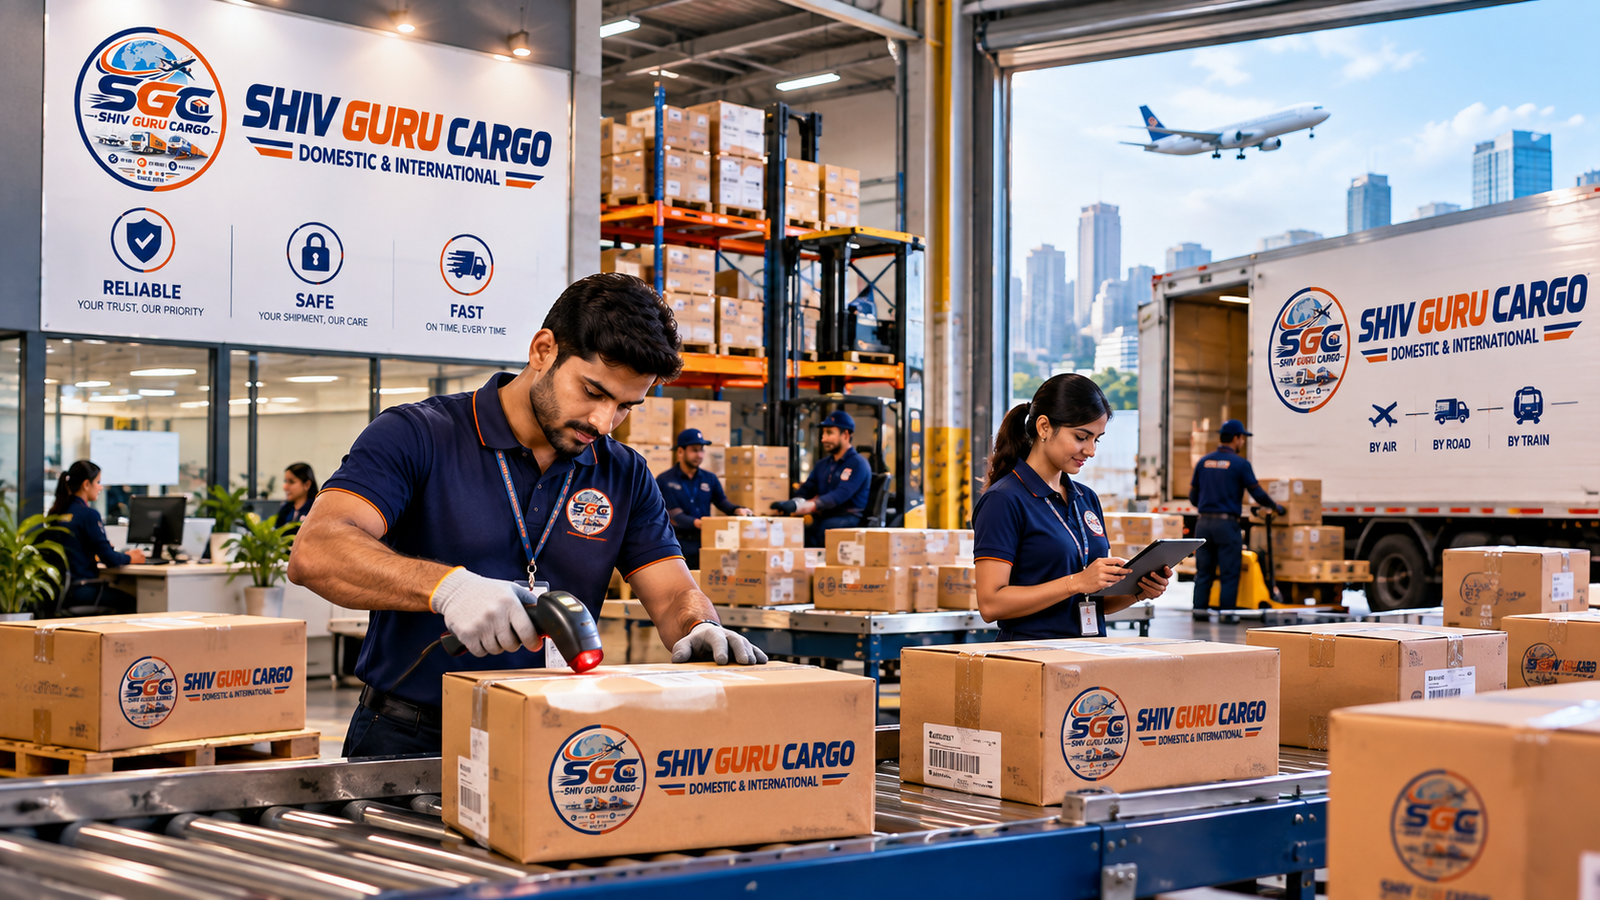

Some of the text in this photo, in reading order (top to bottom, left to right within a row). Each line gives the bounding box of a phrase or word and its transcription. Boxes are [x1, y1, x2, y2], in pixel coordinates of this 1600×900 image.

[91, 75, 215, 123] SGC
[98, 112, 211, 136] SHIV GURU CARGO
[242, 83, 552, 167] SHIV GURU CARGO
[299, 143, 500, 186] DOMESTIC & INTERNATIONAL
[103, 280, 181, 300] RELIABLE
[77, 300, 204, 316] YOUR TRUST, OUR PRIORITY
[295, 292, 334, 310] SAFE
[1358, 273, 1588, 343] SHIV GURU CARGO
[259, 311, 368, 327] YOUR SHIPMENT, OUR CARE
[450, 303, 484, 320] FAST
[425, 322, 507, 335] ON TIME, EVERY TIME
[1276, 324, 1343, 358] SGC
[1391, 328, 1539, 361] DOMESTIC & INTERNATIONAL
[1317, 352, 1340, 364] CARGO
[1369, 441, 1397, 453] BY AIR
[1433, 438, 1471, 450] BY ROAD
[1508, 434, 1550, 447] BY TRAIN
[572, 502, 609, 515] SGC
[125, 678, 174, 697] SGC
[183, 665, 293, 691] SHIV GURU CARGO
[1136, 700, 1267, 732] SHIV GURU CARGO
[1067, 715, 1125, 739] SGC
[1158, 733, 1189, 745] DOMESTIC
[1196, 728, 1243, 742] INTERNATIONAL
[655, 740, 855, 778] SHIV GURU CARGO
[559, 759, 639, 786] SGC
[564, 784, 636, 795] SHIV GURU CARGO
[689, 775, 819, 795] DOMESTIC & INTERNATIONAL
[1403, 804, 1479, 834] SGC
